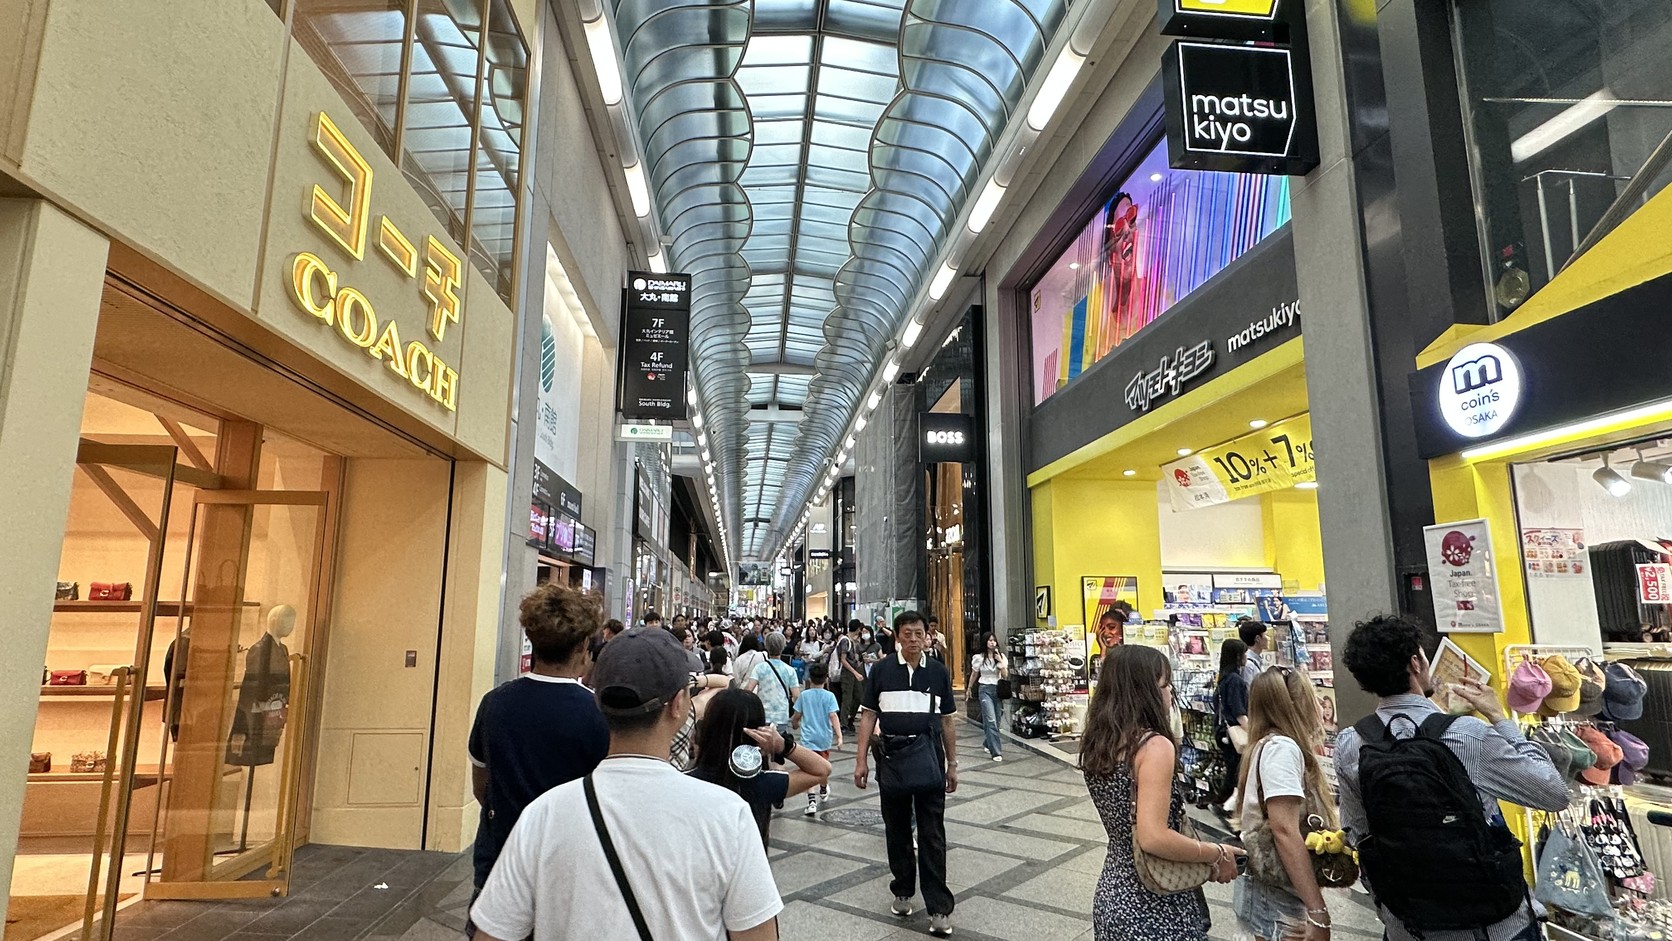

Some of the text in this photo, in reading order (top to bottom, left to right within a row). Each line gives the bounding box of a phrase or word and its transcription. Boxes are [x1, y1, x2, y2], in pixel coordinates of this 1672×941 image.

[1192, 94, 1287, 119] matsu
[1193, 114, 1251, 150] kiyo
[309, 111, 463, 342] コーチ
[285, 251, 459, 412] COACH
[652, 318, 665, 328] 7F
[650, 352, 664, 361] 4F
[1452, 354, 1503, 395] m
[1461, 389, 1500, 411] coin's
[1465, 410, 1498, 426] OSAKA
[926, 430, 964, 444] BOSS
[1449, 569, 1473, 578] Japan.
